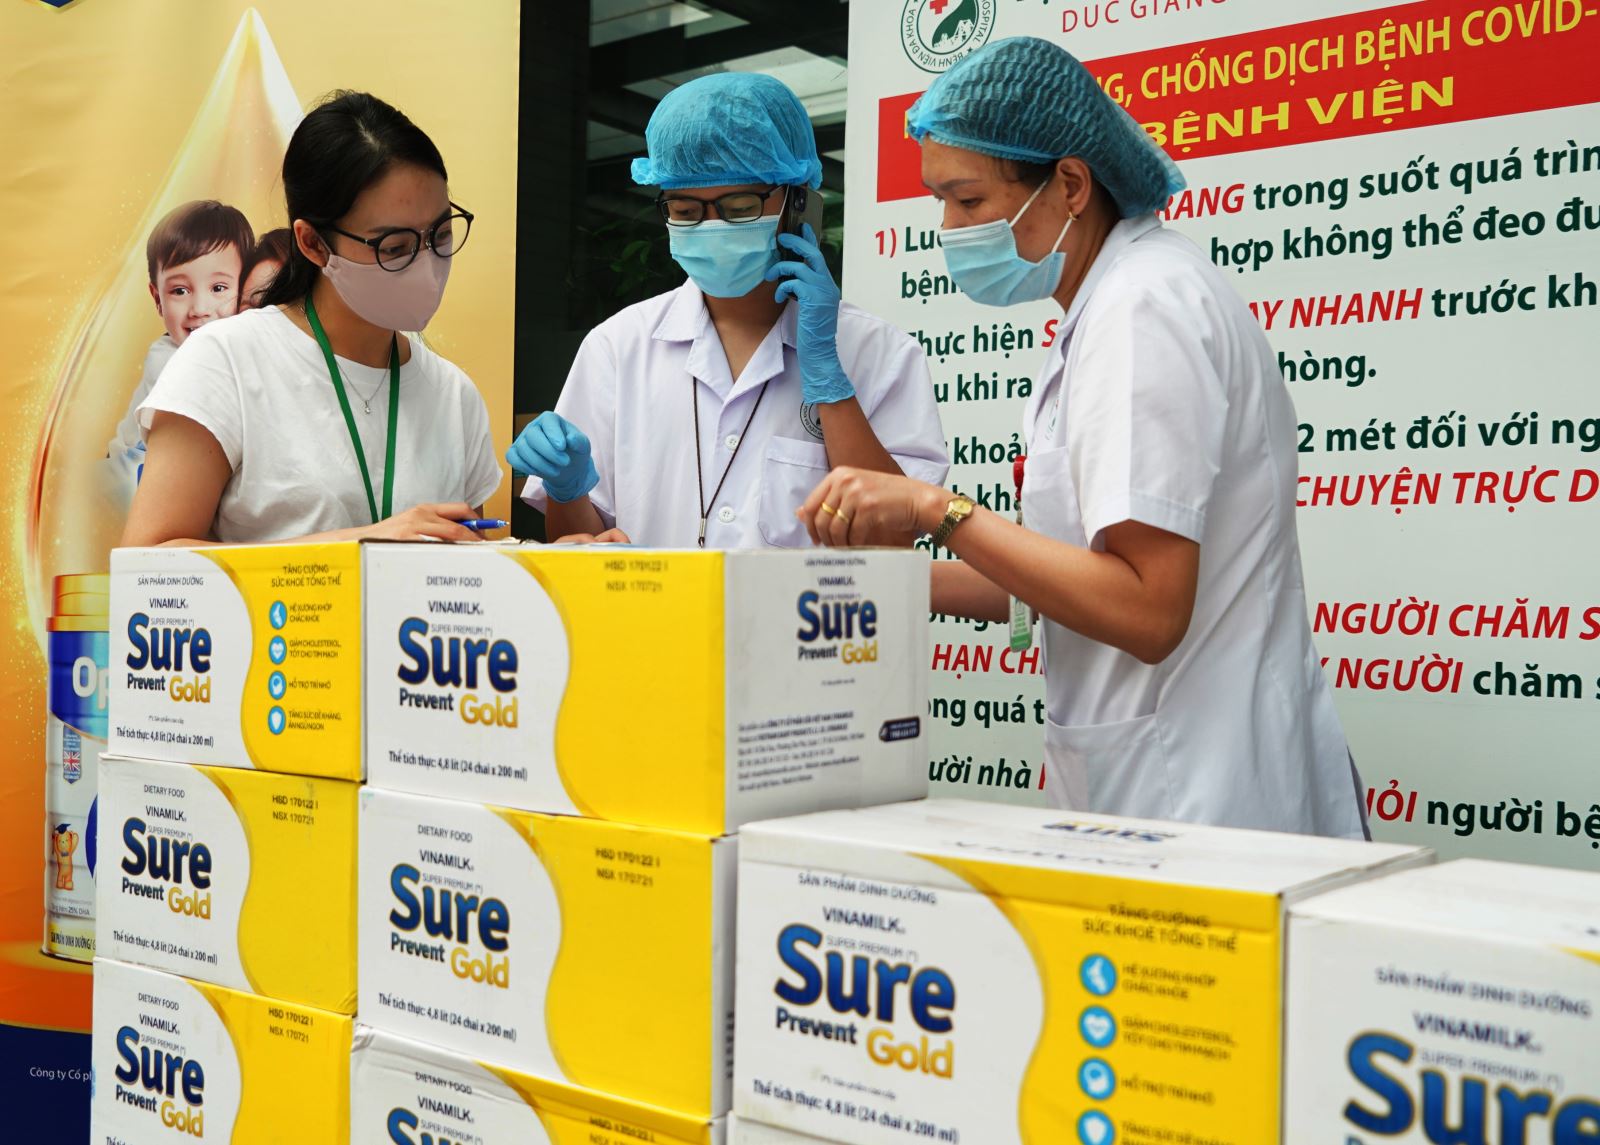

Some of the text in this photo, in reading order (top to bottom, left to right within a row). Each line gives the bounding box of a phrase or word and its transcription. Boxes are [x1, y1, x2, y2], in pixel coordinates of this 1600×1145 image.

[906, 8, 916, 38] KHOA
[1061, 1, 1120, 33] DUC
[1140, 47, 1254, 99] CHỐNG
[1264, 34, 1344, 86] DỊCH
[1355, 16, 1450, 71] BỆNH
[1461, 0, 1598, 46] COVID-
[1139, 76, 1454, 153] BỆNH VIỆN
[874, 228, 897, 258] 1)
[1253, 176, 1349, 211] trong
[1359, 154, 1439, 198] suốt
[1449, 146, 1523, 195] quá
[1210, 237, 1274, 273] hợp
[1283, 224, 1392, 260] không
[1403, 204, 1466, 248] thể
[1473, 205, 1546, 241] đeo
[908, 330, 966, 364] hực
[973, 322, 1034, 359] hiện
[1289, 288, 1423, 329] NHANH
[1431, 279, 1536, 318] trước
[957, 371, 998, 401] khi
[1006, 376, 1033, 399] ra
[953, 432, 1028, 465] khoả
[1297, 422, 1315, 453] 2
[1325, 418, 1397, 452] mét
[1406, 410, 1467, 450] đối
[1478, 411, 1539, 447] với
[1296, 466, 1442, 515] CHUYỆN
[1452, 464, 1561, 514] TRỰC
[426, 575, 483, 588] DIETARY FOOD
[797, 589, 877, 642] Sure
[1313, 596, 1440, 637] NGƯỜI
[1448, 597, 1571, 641] CHĂM
[126, 612, 212, 673] Sure
[398, 616, 519, 693] Sure
[798, 640, 879, 665] Prevent Gold
[127, 673, 212, 704] Prevent Gold
[931, 643, 1583, 700] HẠN CH NGƯỜI chăm
[399, 687, 519, 728] Prevent Gold
[973, 694, 1025, 729] quá
[144, 783, 185, 799] DIETARY FOOD
[437, 759, 450, 770] 4,8
[460, 760, 473, 773] (24
[473, 762, 490, 775] chai
[497, 765, 513, 778] 200
[513, 766, 528, 782] ml)
[290, 797, 314, 810] 170122
[976, 758, 1032, 790] nhà
[1427, 797, 1543, 838] người
[121, 816, 212, 890] Sure
[417, 824, 473, 844] DIETARY FOOD
[122, 876, 212, 920] Prevent Gold
[389, 862, 511, 952] Sure
[150, 939, 160, 952] 4,8
[167, 942, 178, 955] (24
[178, 945, 190, 959] chai
[195, 949, 207, 962] 200
[207, 951, 219, 966] ml)
[391, 931, 510, 990] Prevent Gold
[774, 922, 956, 1034] Sure
[138, 992, 180, 1011] DIETARY FOOD
[286, 1011, 310, 1025] 170122
[427, 1006, 439, 1020] 4,8
[449, 1010, 463, 1025] (24
[463, 1015, 479, 1031] chai
[486, 1022, 502, 1037] 200
[502, 1027, 517, 1042] ml)
[776, 1006, 955, 1080] Prevent Gold
[29, 1066, 55, 1080] Công
[57, 1069, 67, 1081] ty
[115, 1025, 205, 1107] Sure
[415, 1071, 473, 1095] DIETARY FOOD
[116, 1084, 205, 1138] Prevent Gold
